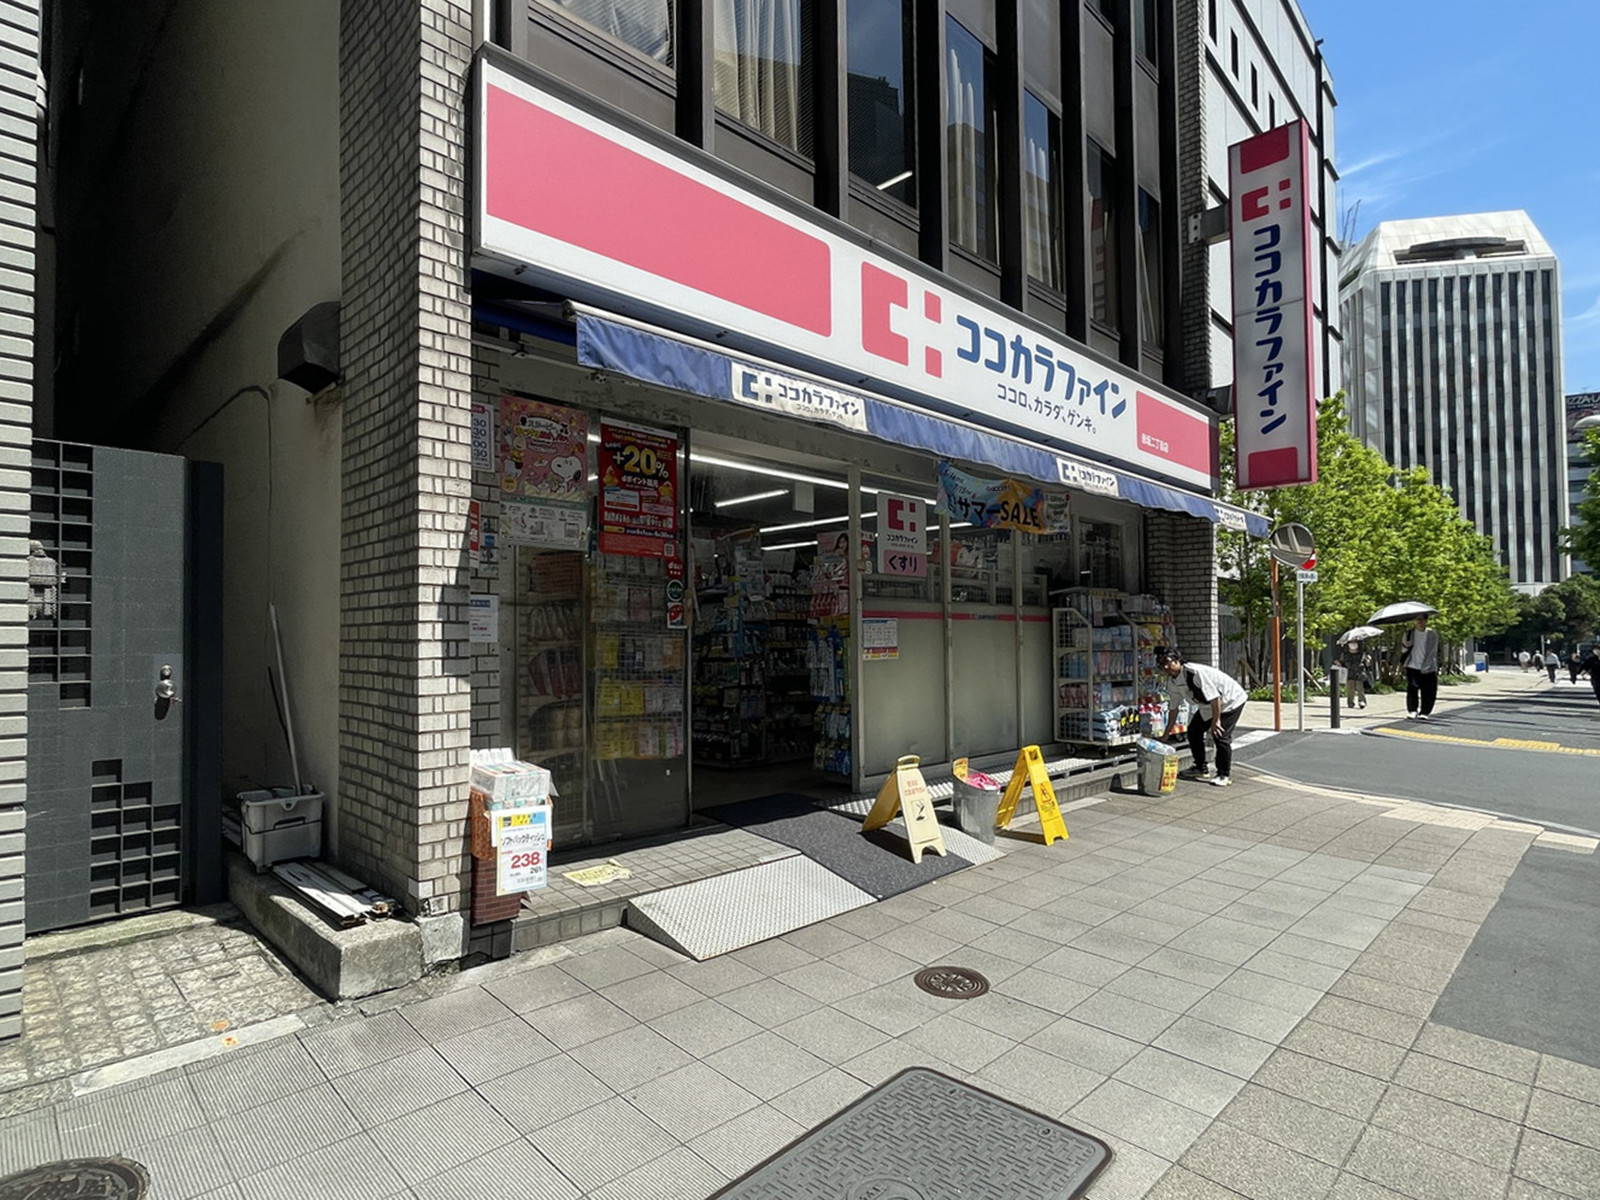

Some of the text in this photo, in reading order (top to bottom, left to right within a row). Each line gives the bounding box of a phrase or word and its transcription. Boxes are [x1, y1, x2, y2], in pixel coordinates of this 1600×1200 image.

[1254, 223, 1287, 435] ココカラファイン
[956, 314, 1127, 419] ココカラファイン
[778, 382, 860, 416] ココカラファイン
[997, 384, 1097, 435] ココロ、カラダ、ゲンキ。
[612, 444, 669, 479] +20%
[888, 555, 918, 573] くすり
[511, 851, 541, 869] 238
